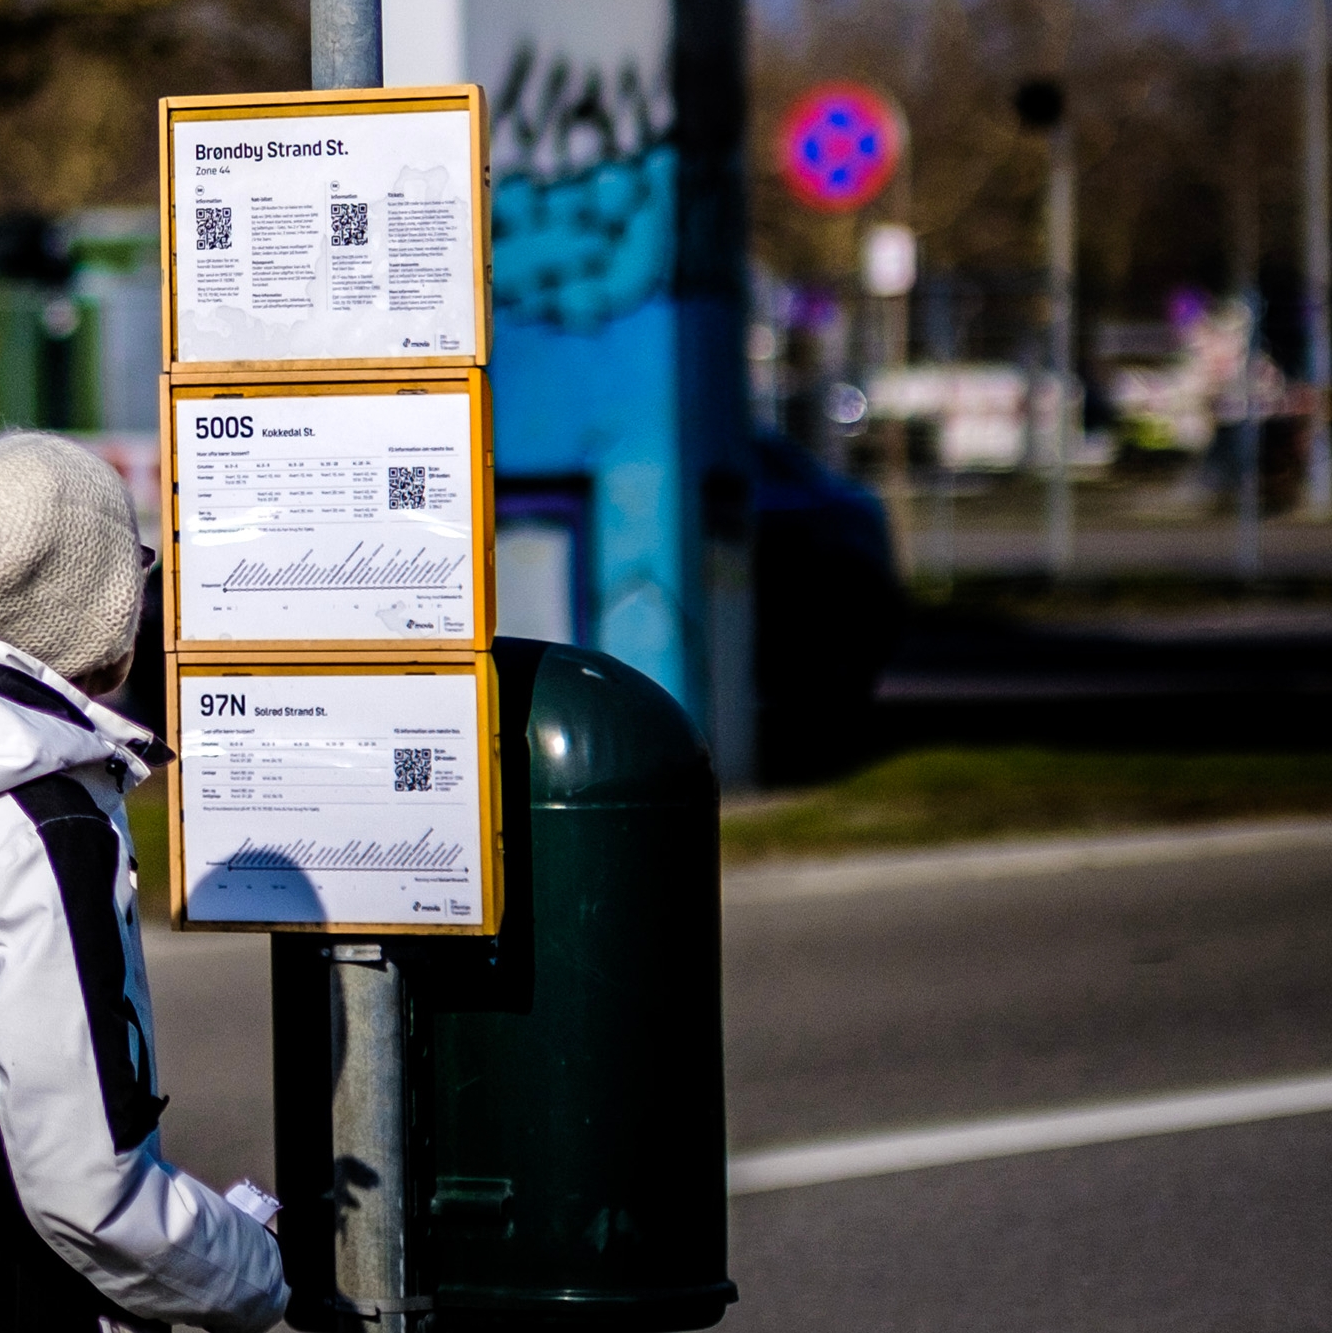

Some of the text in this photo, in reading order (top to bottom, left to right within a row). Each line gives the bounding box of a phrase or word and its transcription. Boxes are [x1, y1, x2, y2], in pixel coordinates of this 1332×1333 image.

[195, 139, 349, 162] Brøndby Strand St.
[195, 165, 231, 176] Zone 44
[196, 415, 316, 439] 500S Kokkedal St.
[200, 694, 246, 717] 97N
[284, 707, 314, 717] Strand
[315, 706, 328, 717] St.
